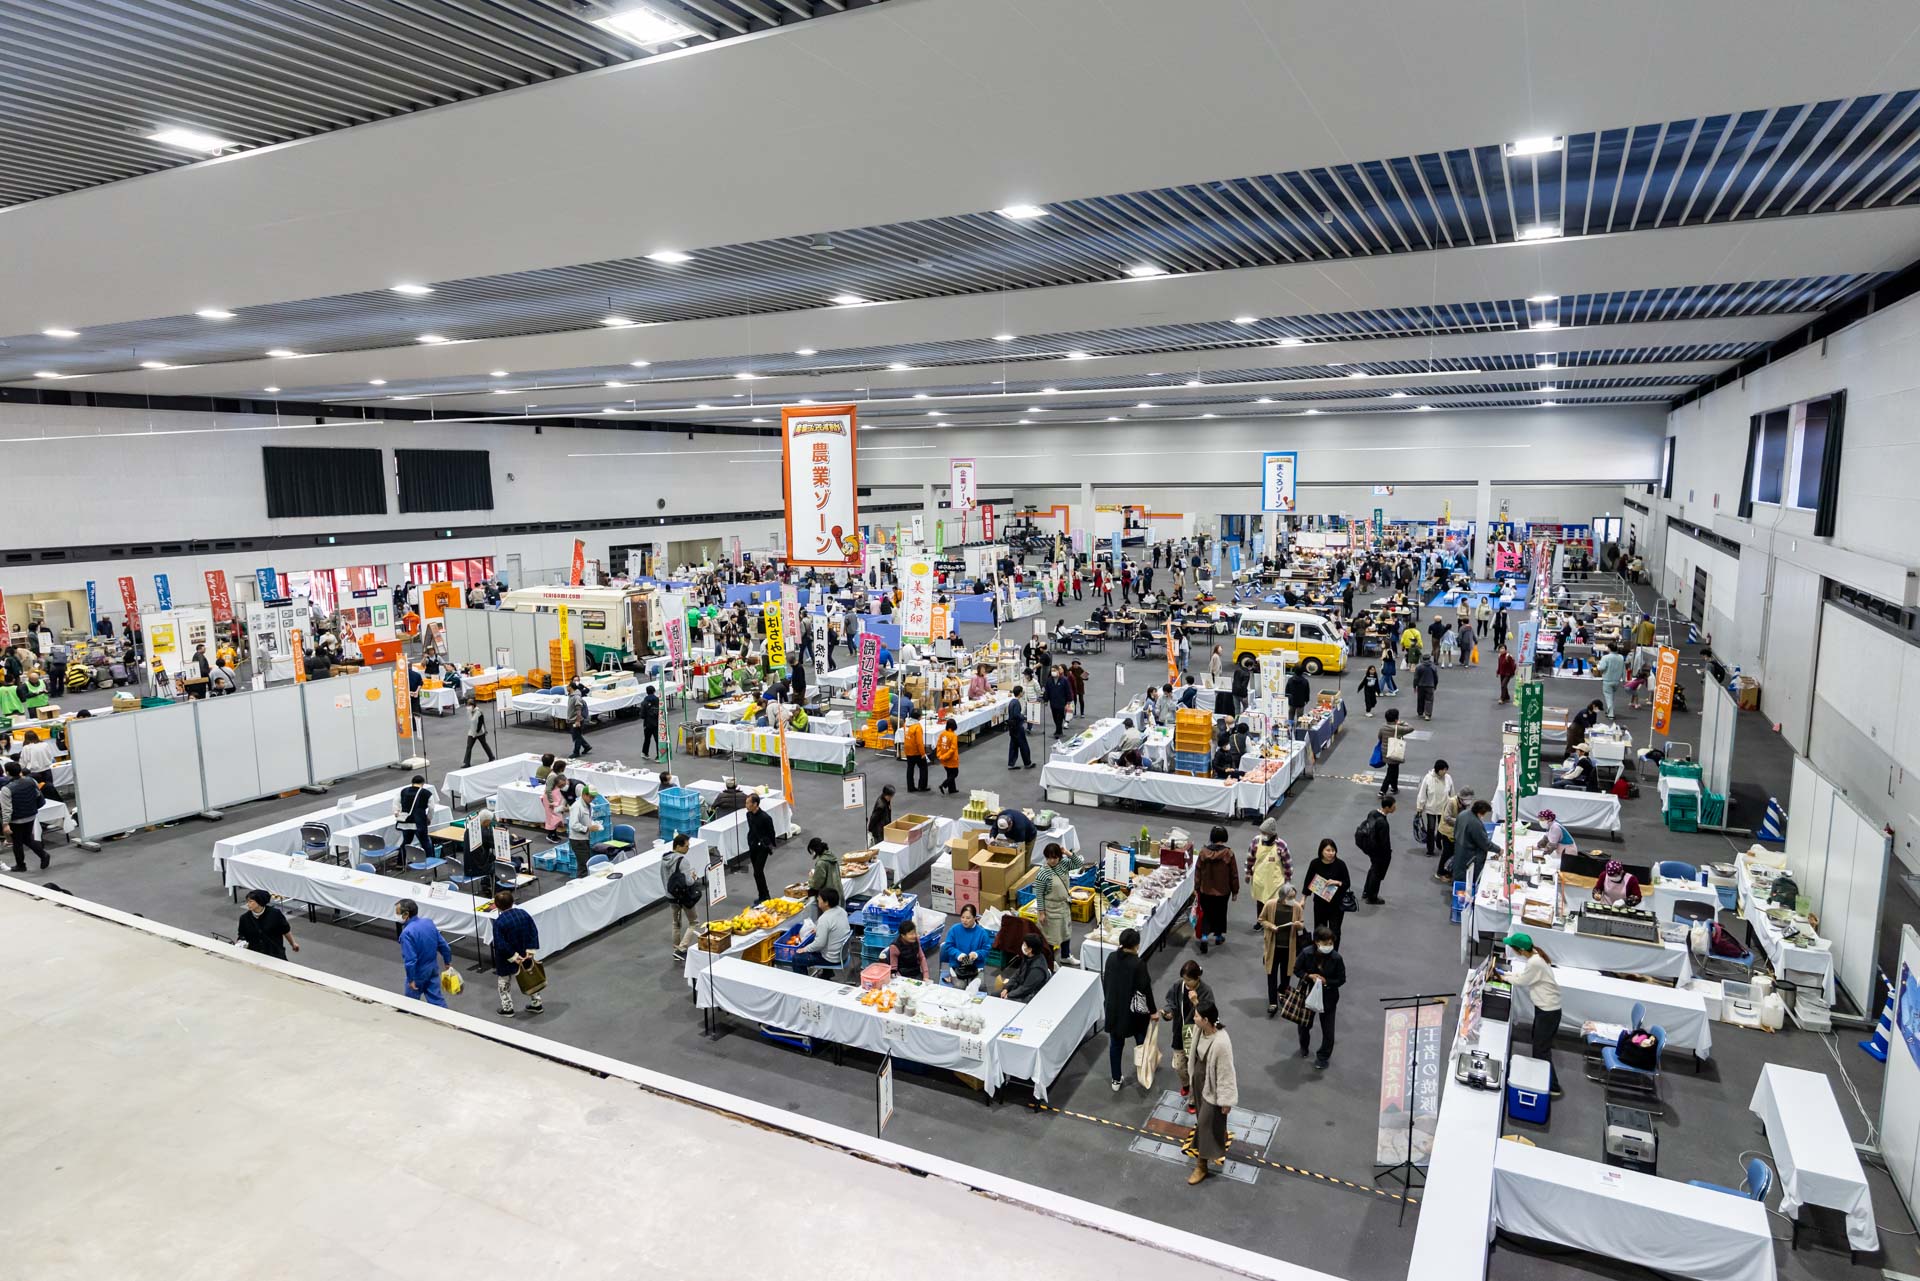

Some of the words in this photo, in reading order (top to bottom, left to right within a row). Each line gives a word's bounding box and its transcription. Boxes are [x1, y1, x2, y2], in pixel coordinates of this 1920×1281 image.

[812, 442, 831, 555] 農業ゾーン
[1275, 463, 1284, 508] まぐろゾーン
[909, 580, 925, 624] 美黄卵
[861, 639, 876, 705] 磯辺焼き
